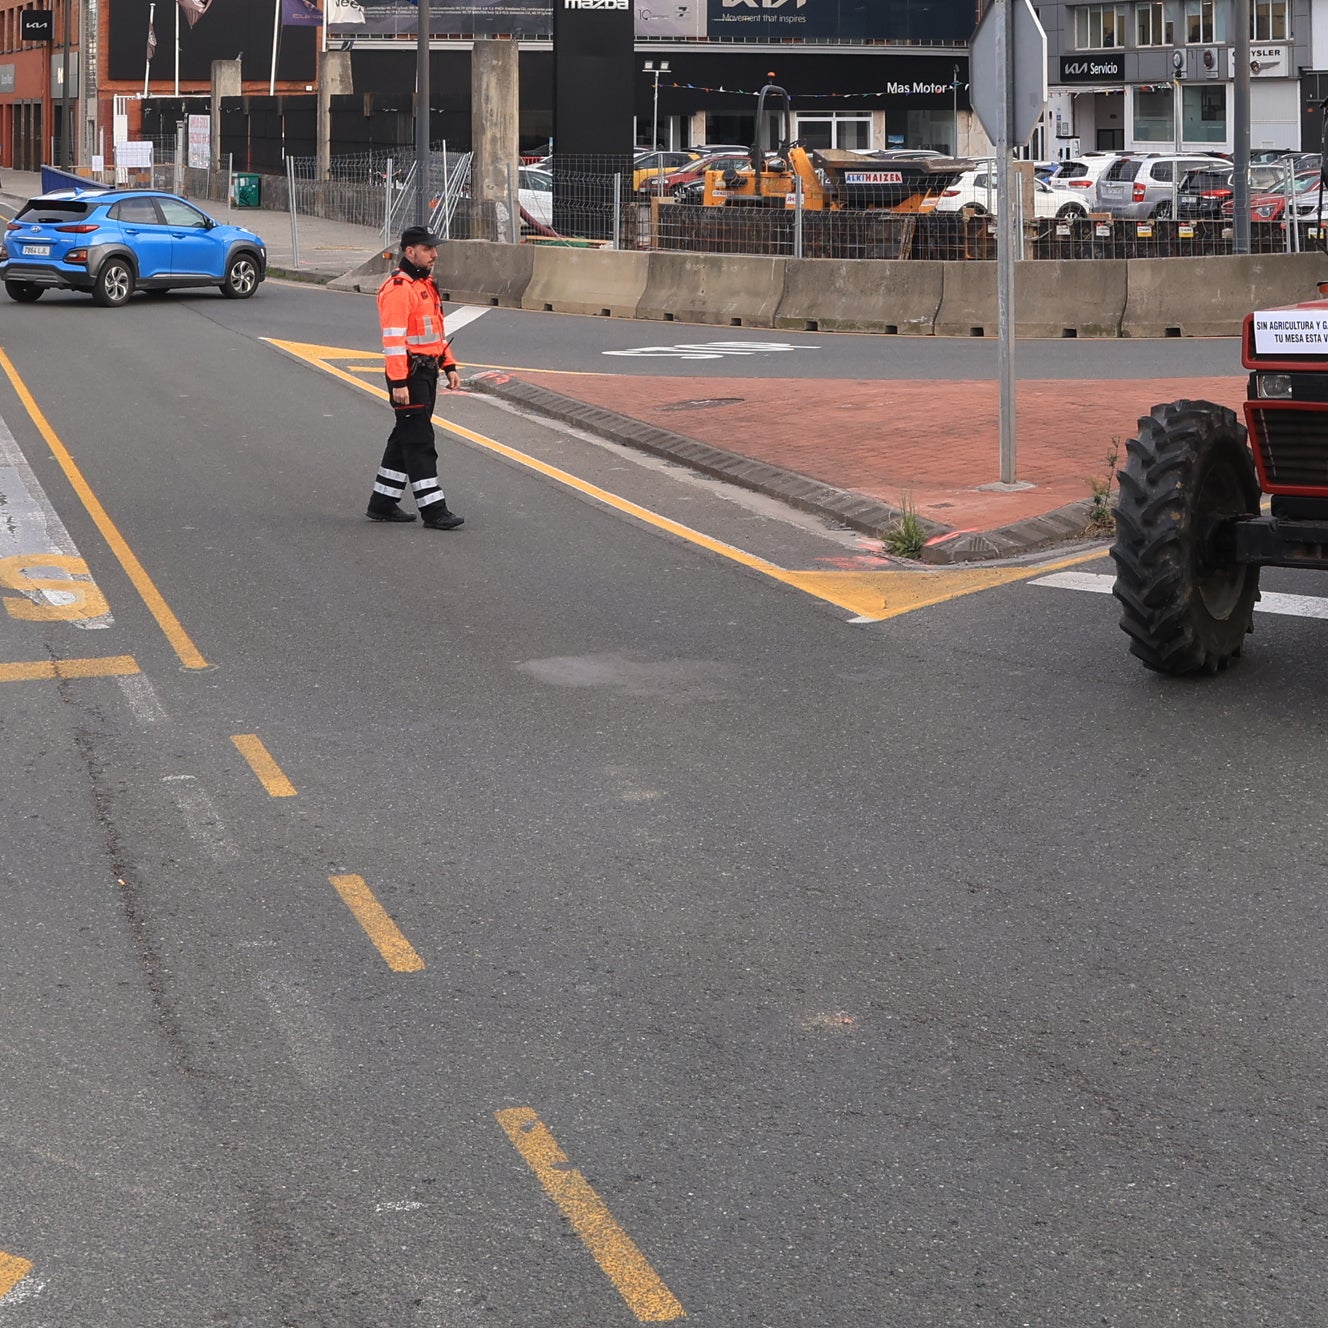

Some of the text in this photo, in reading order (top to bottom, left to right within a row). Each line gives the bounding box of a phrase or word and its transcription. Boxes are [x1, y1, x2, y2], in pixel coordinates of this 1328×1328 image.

[722, 13, 806, 24] Movement that inspires
[1232, 49, 1281, 57] YSLER
[1090, 63, 1118, 75] Servicio
[887, 82, 947, 94] Mas Motor
[846, 174, 902, 182] ALKIHAIZEA
[1256, 321, 1268, 330] SIN
[1270, 321, 1314, 330] AGRICULTURA
[1316, 321, 1321, 330] Y
[1275, 334, 1284, 343] TU
[1285, 334, 1304, 343] MESA
[1305, 334, 1322, 343] ESTA
